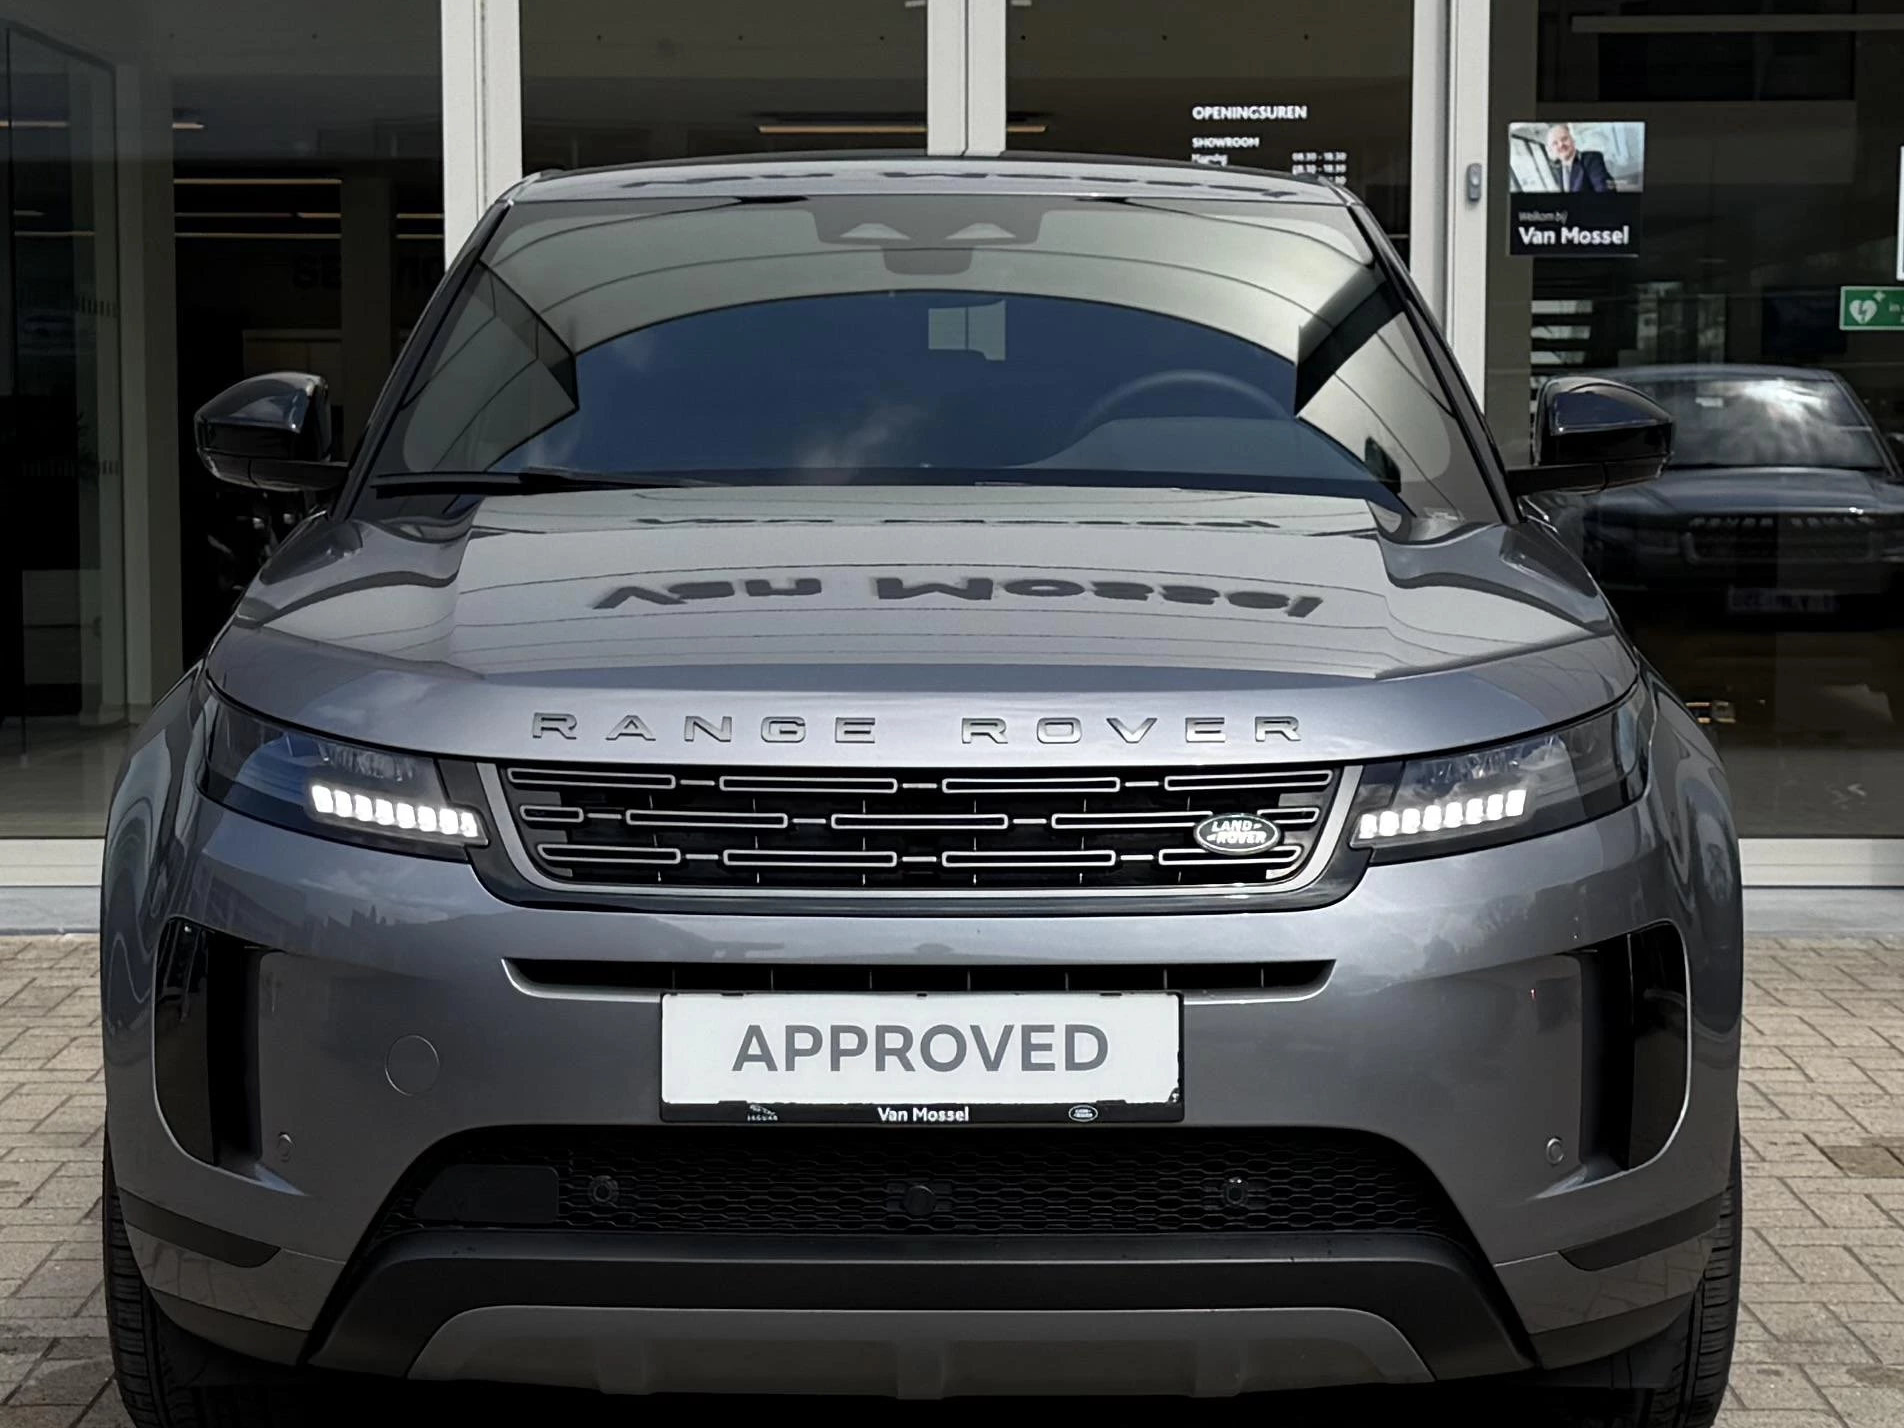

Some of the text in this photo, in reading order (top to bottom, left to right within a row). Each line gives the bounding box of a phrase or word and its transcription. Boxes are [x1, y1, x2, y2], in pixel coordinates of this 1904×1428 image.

[1192, 105, 1308, 120] OPENINGSUREN
[1192, 136, 1260, 149] SHOWROOM
[1518, 224, 1630, 245] Van Mossel
[530, 711, 1302, 744] RANGE ROVER
[1211, 819, 1253, 832] LAND
[1216, 831, 1267, 844] ROVER
[731, 1023, 1110, 1073] APPROVED
[877, 1107, 909, 1122] Van
[912, 1106, 970, 1122] Mossel
